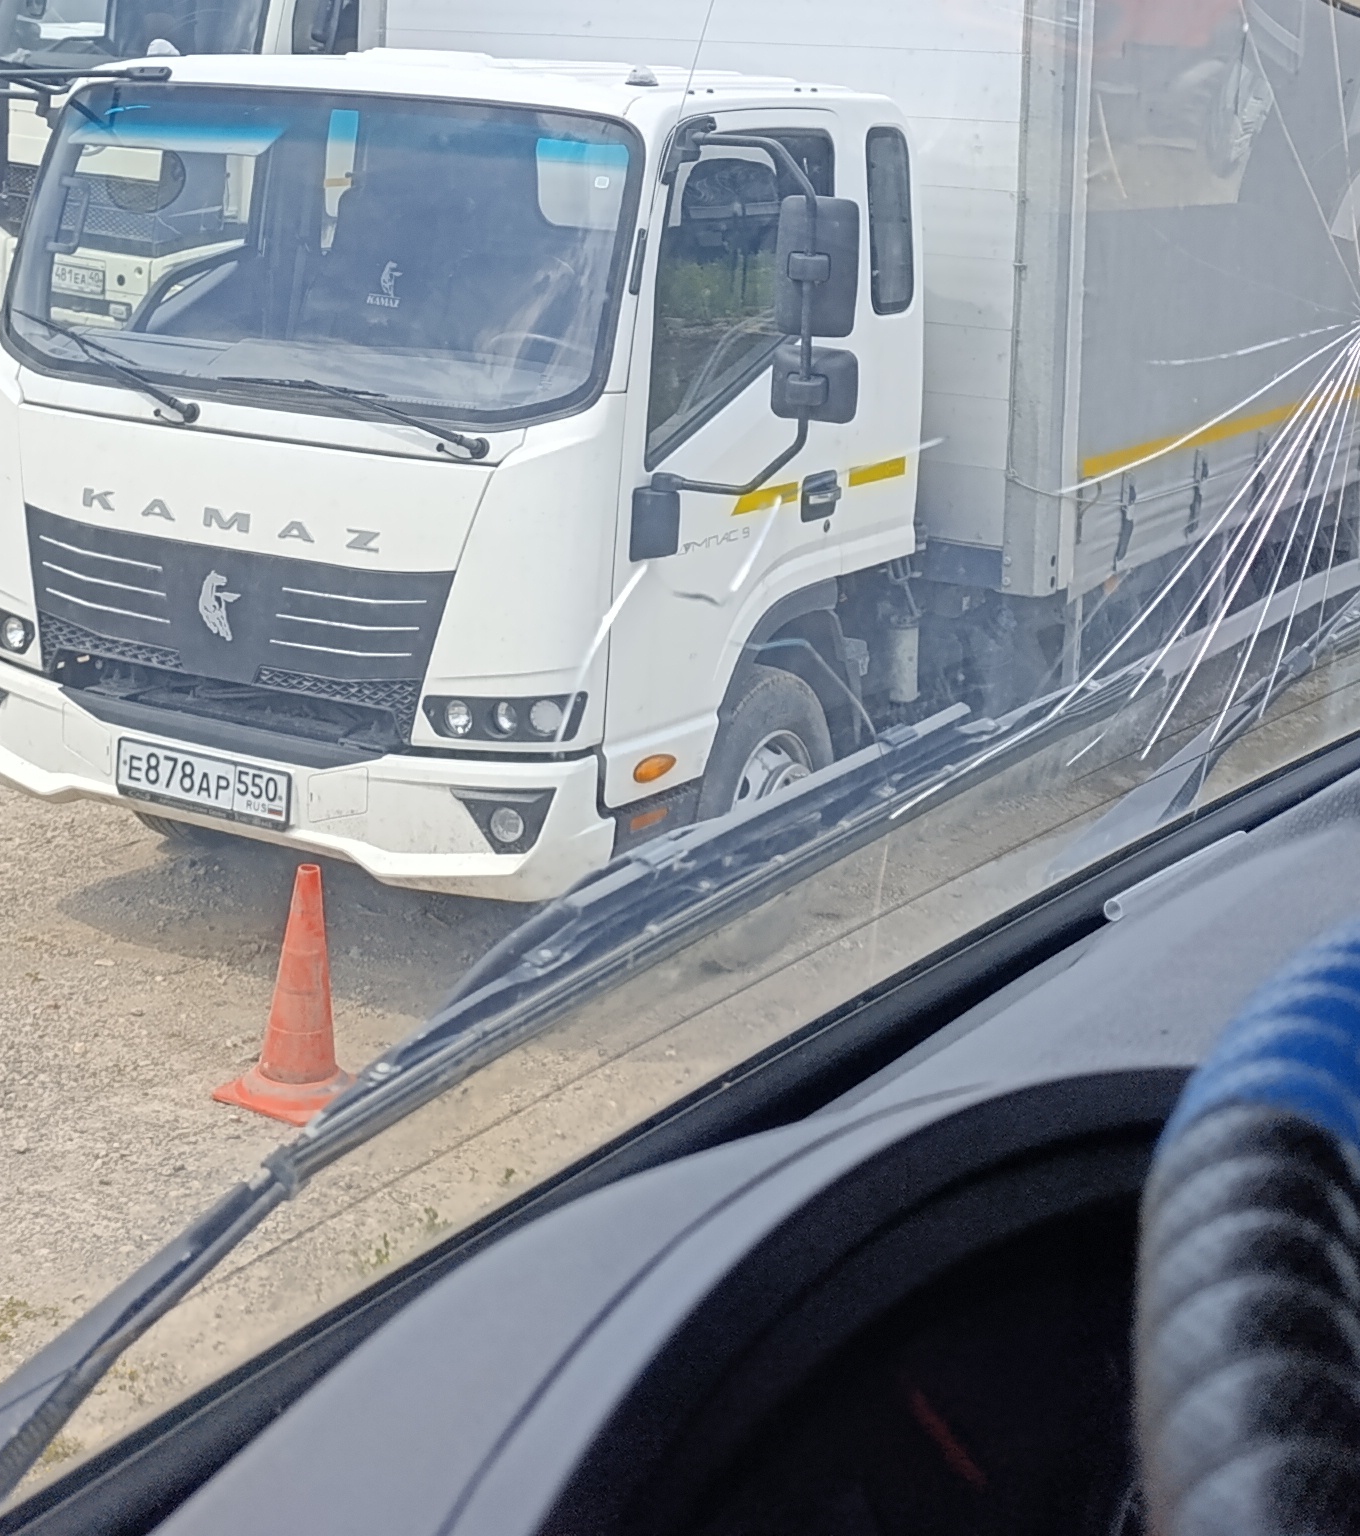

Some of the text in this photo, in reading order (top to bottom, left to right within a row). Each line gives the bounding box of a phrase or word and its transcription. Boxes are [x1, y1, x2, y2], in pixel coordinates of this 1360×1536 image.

[82, 487, 380, 553] KAMAZ
[237, 770, 278, 802] 550
[246, 800, 267, 813] RUS
